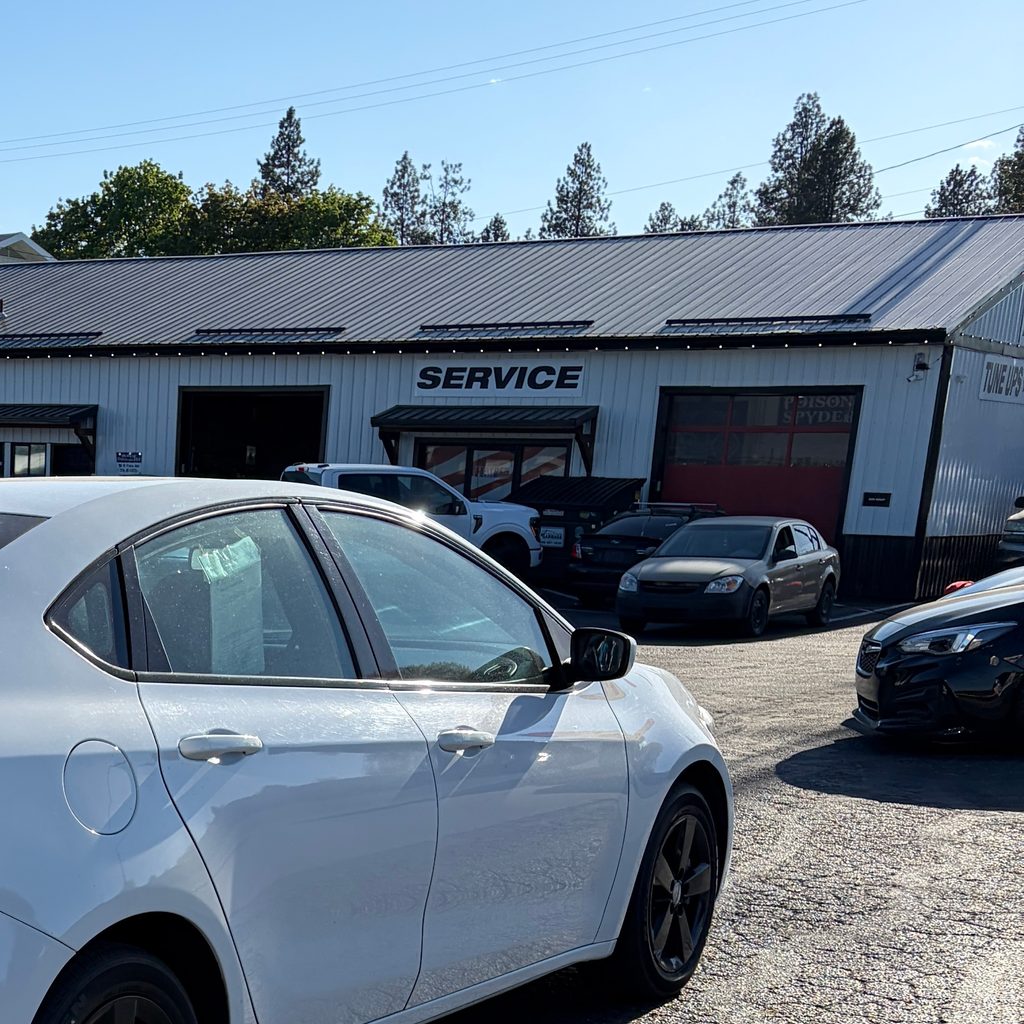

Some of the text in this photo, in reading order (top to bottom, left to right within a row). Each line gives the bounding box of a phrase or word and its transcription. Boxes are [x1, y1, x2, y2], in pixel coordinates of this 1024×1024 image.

[417, 366, 583, 390] SERVICE
[983, 362, 1007, 394] TUNE
[784, 395, 855, 410] POISON
